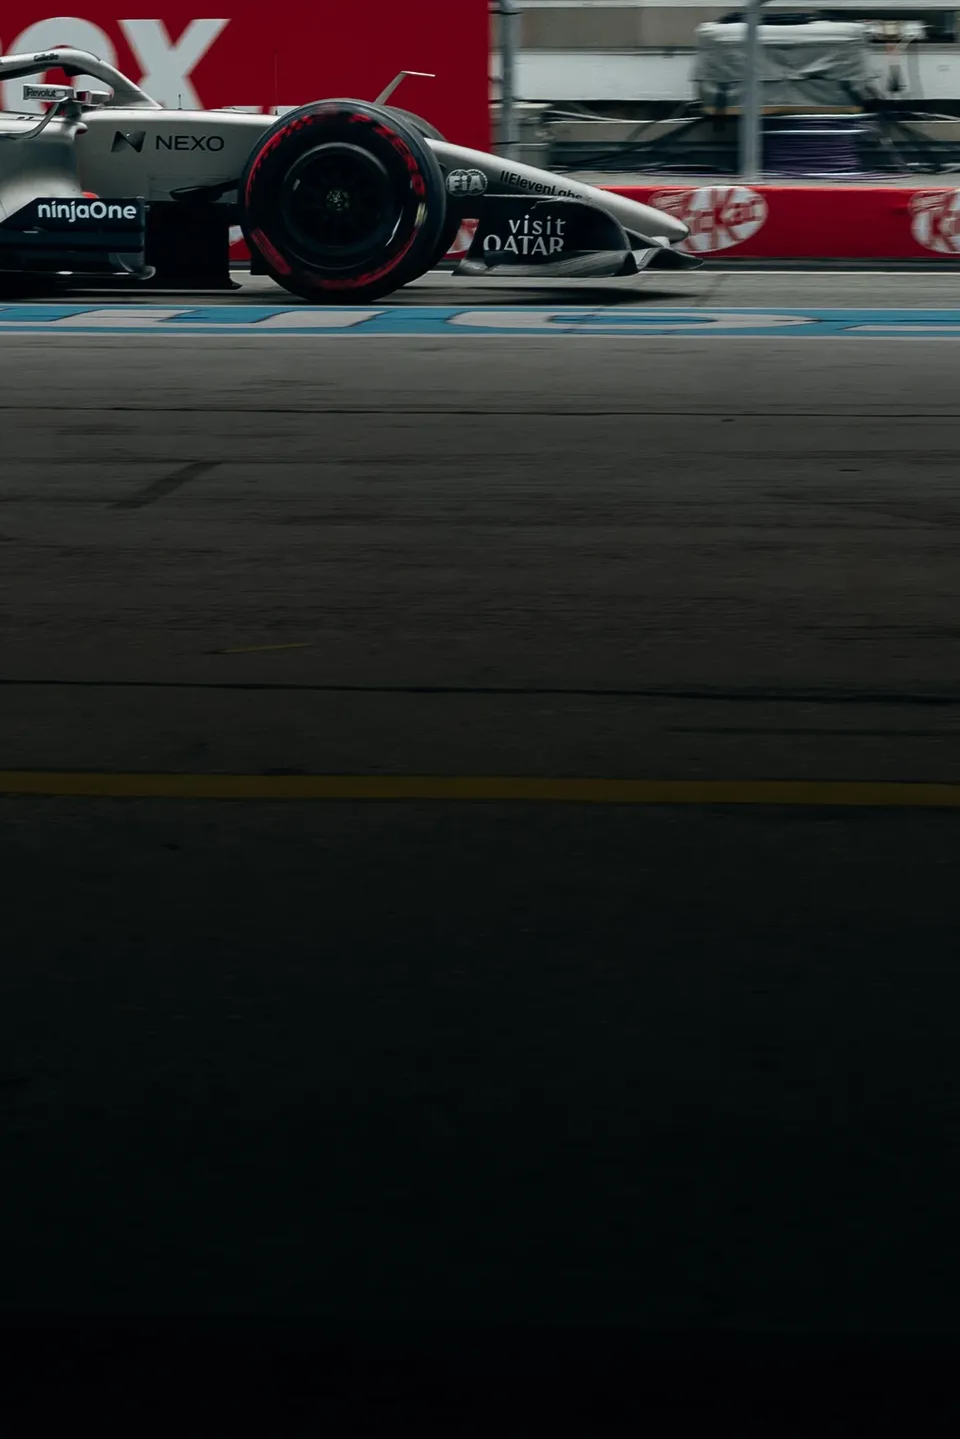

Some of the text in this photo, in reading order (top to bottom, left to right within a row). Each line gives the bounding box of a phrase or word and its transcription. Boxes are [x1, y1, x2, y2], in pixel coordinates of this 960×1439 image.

[26, 87, 57, 98] Revolut
[155, 135, 225, 152] NEXO
[37, 200, 137, 223] ninjaOne
[508, 214, 567, 236] visit
[482, 233, 565, 257] QATAR
